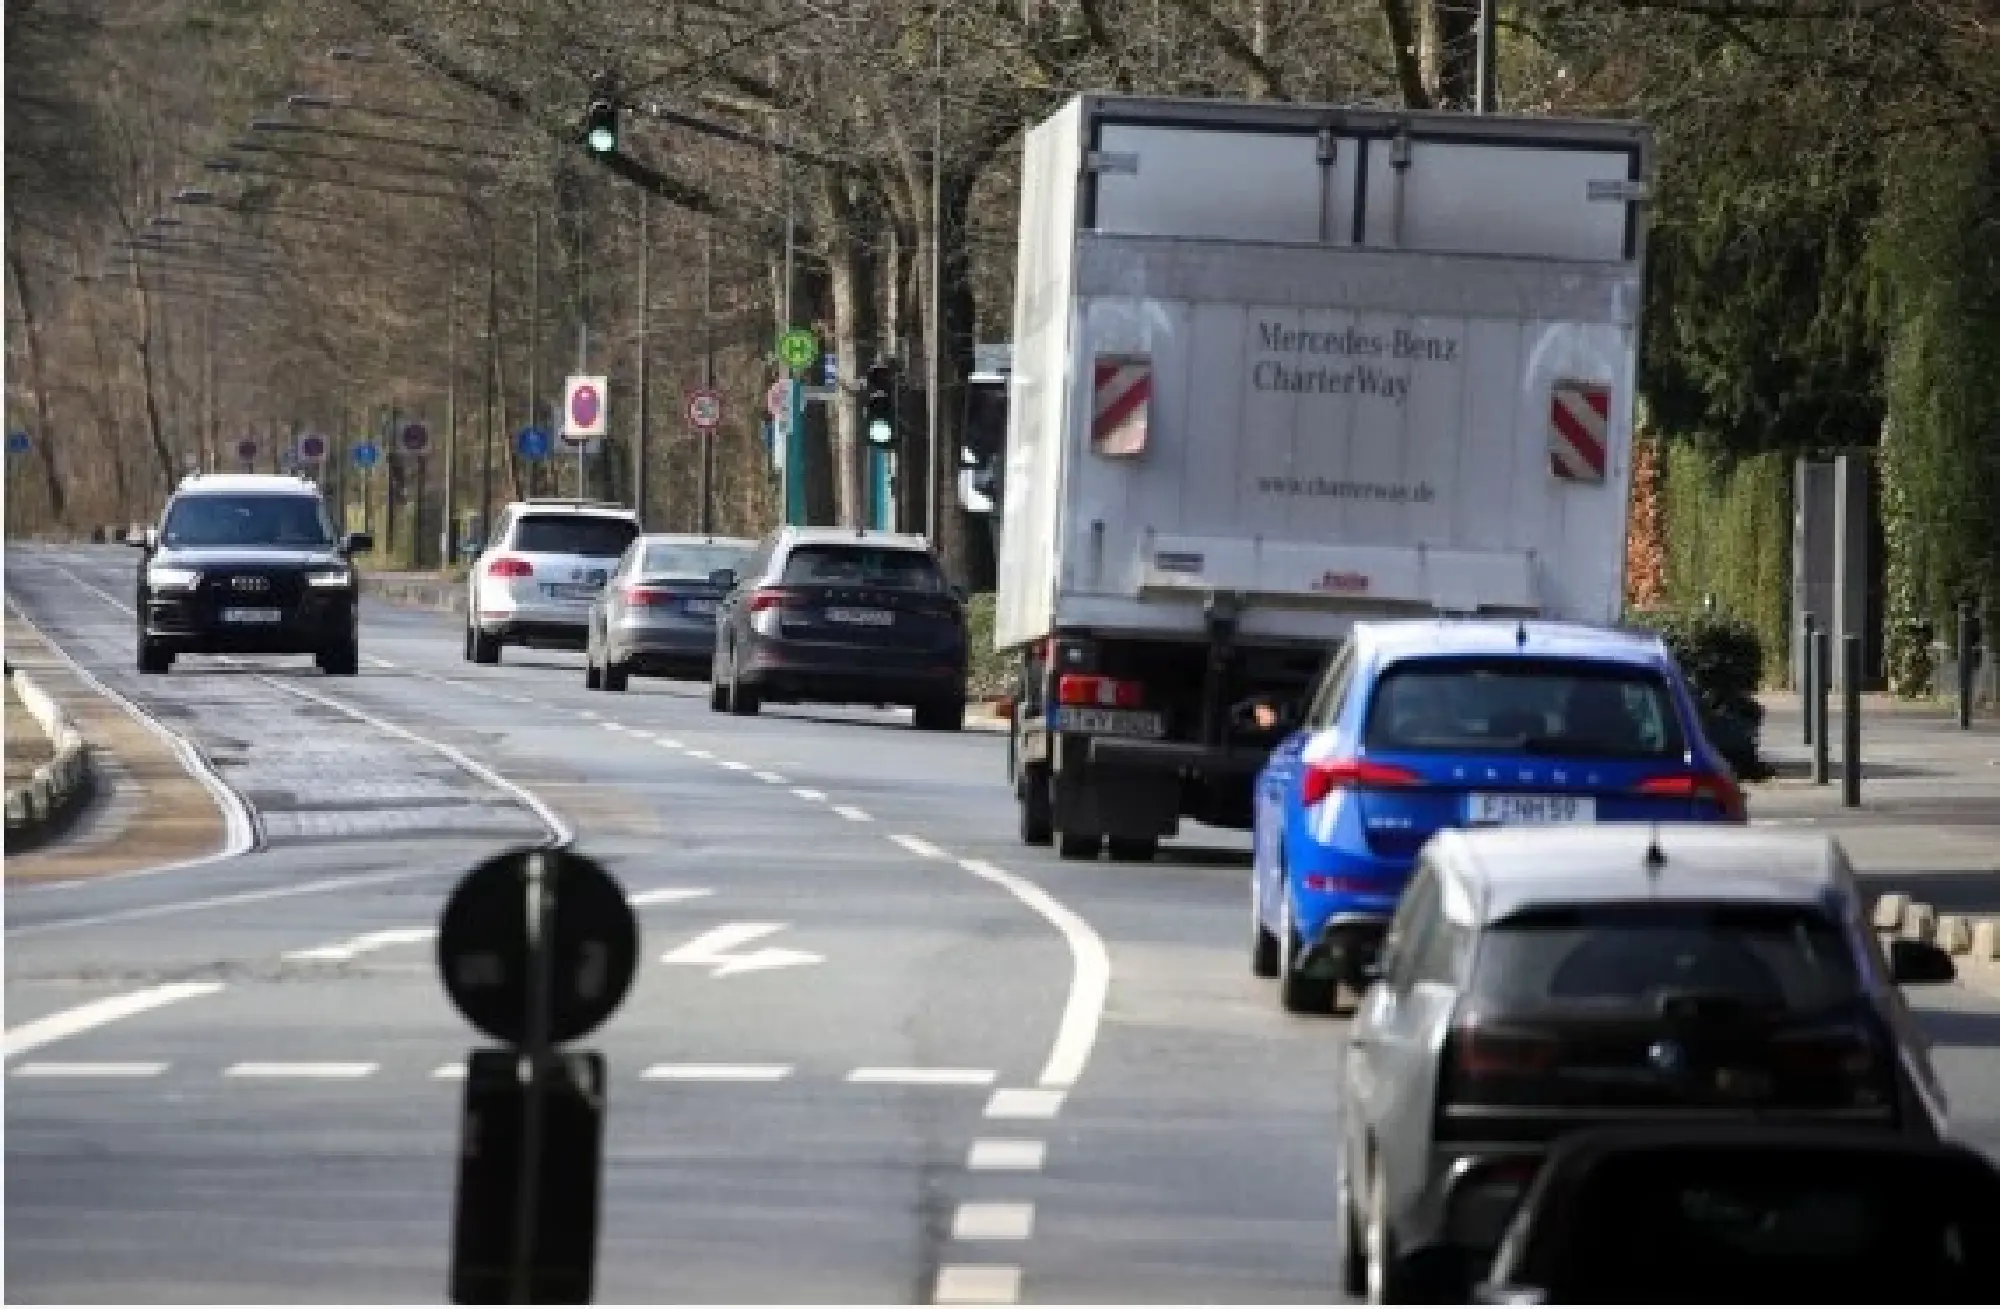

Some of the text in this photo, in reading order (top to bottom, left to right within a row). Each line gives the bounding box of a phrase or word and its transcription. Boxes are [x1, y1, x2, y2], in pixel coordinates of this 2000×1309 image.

[788, 339, 805, 359] H
[1260, 321, 1460, 361] Mercedes-Benz
[1253, 361, 1411, 406] CharterWay
